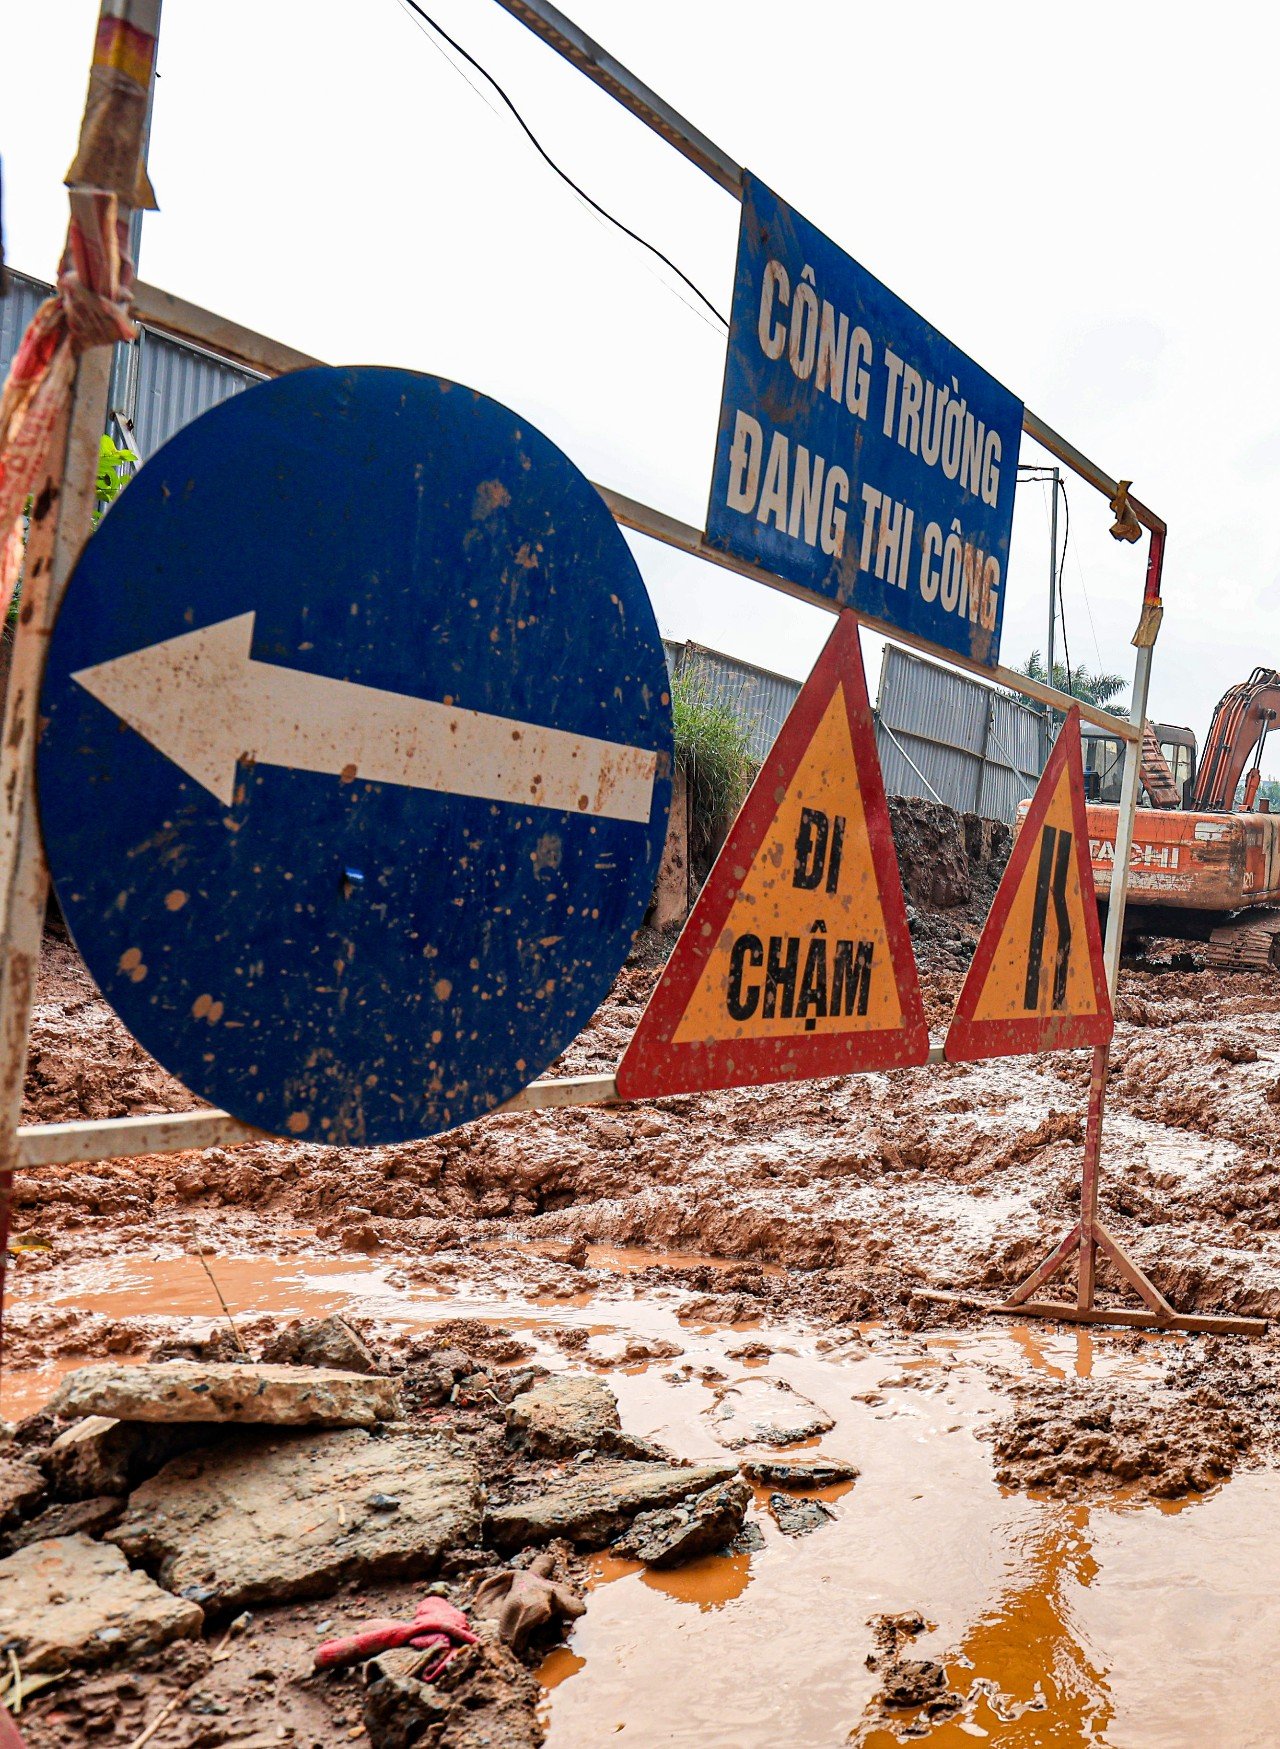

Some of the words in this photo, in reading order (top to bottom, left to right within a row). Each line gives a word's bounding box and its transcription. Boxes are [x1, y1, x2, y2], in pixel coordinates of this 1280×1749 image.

[757, 259, 873, 421] CÔNG
[881, 347, 1002, 509] TRƯỜNG
[726, 409, 849, 559] ĐANG
[859, 483, 914, 590] THI
[919, 518, 1001, 632] CÔNG
[791, 806, 847, 894] ĐI
[726, 919, 875, 1031] CHẬM
